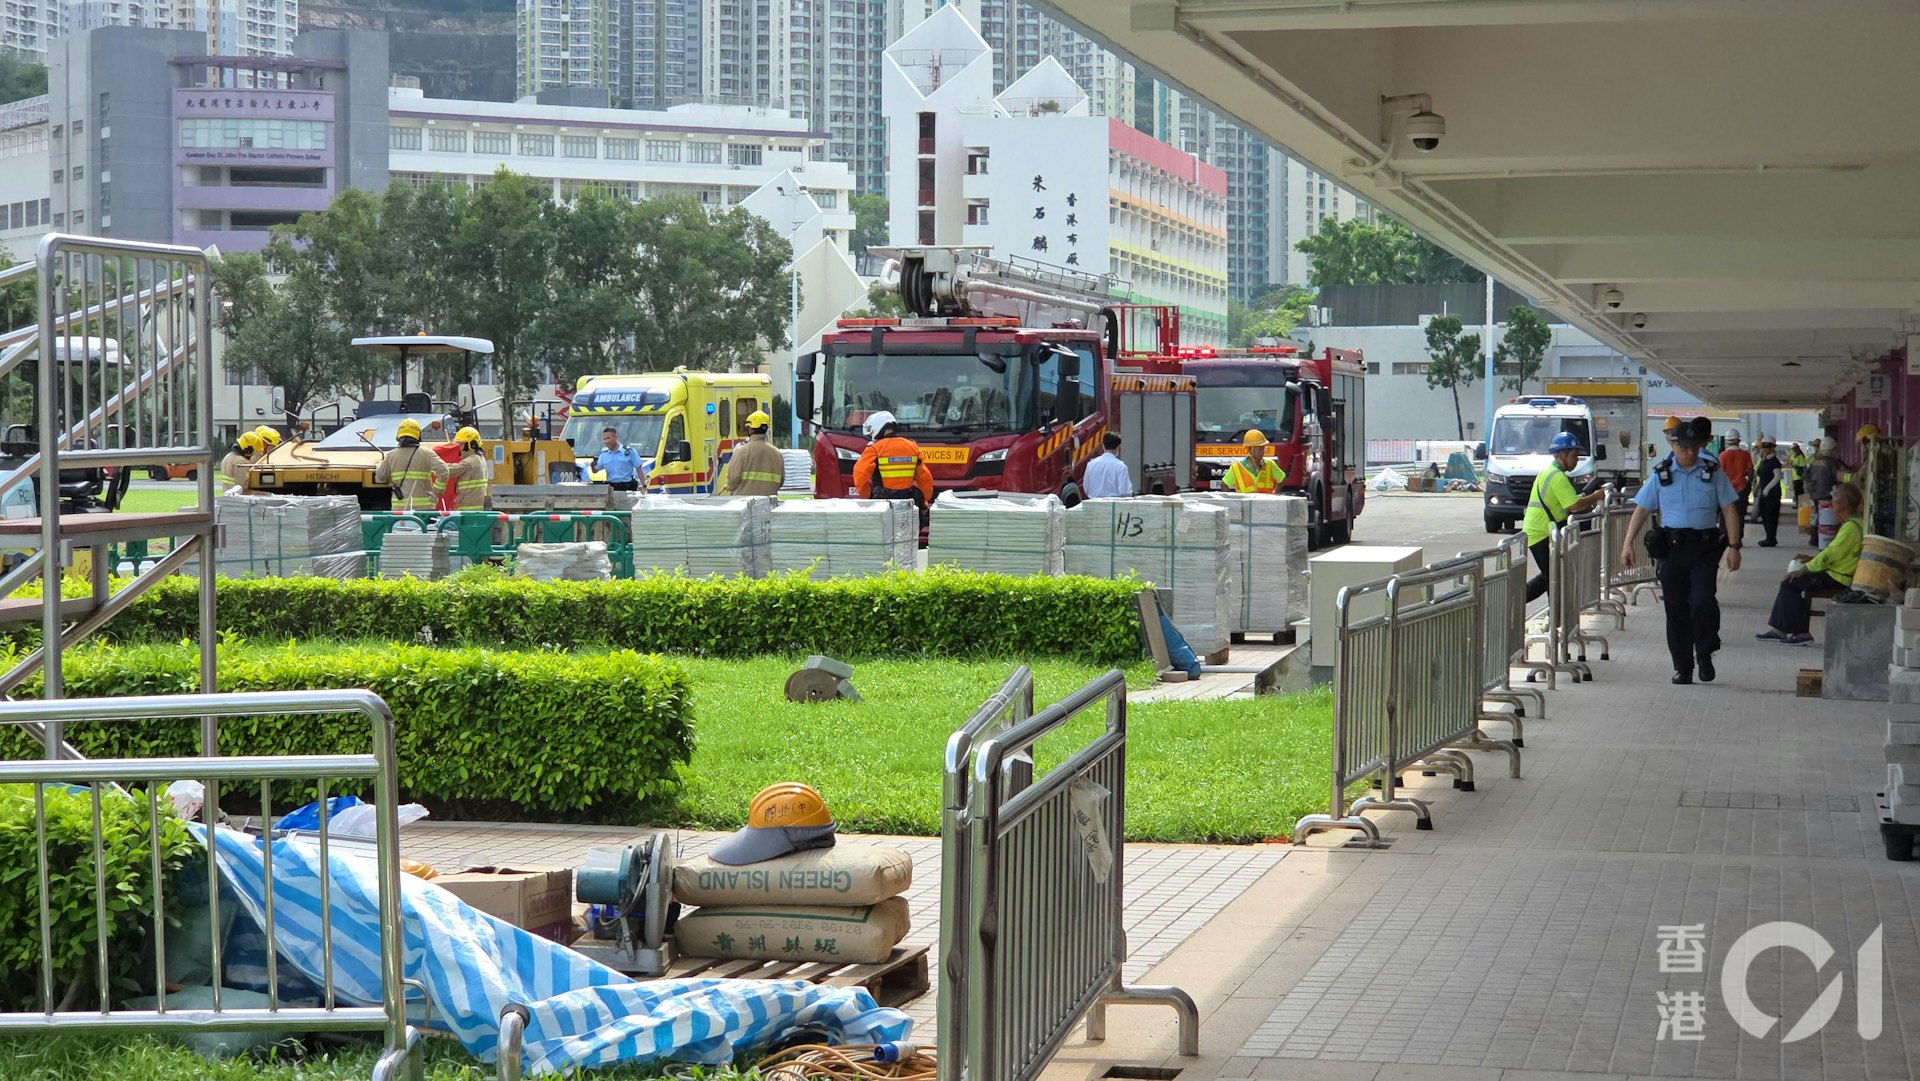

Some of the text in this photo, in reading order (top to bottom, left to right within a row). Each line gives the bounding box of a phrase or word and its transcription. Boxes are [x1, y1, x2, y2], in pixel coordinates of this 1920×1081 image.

[593, 393, 642, 403] AMBULANCE
[922, 450, 952, 460] RVICES
[1216, 446, 1249, 455] SERVIC
[305, 472, 341, 480] HITACHI
[699, 869, 852, 894] GREEN ISLAND
